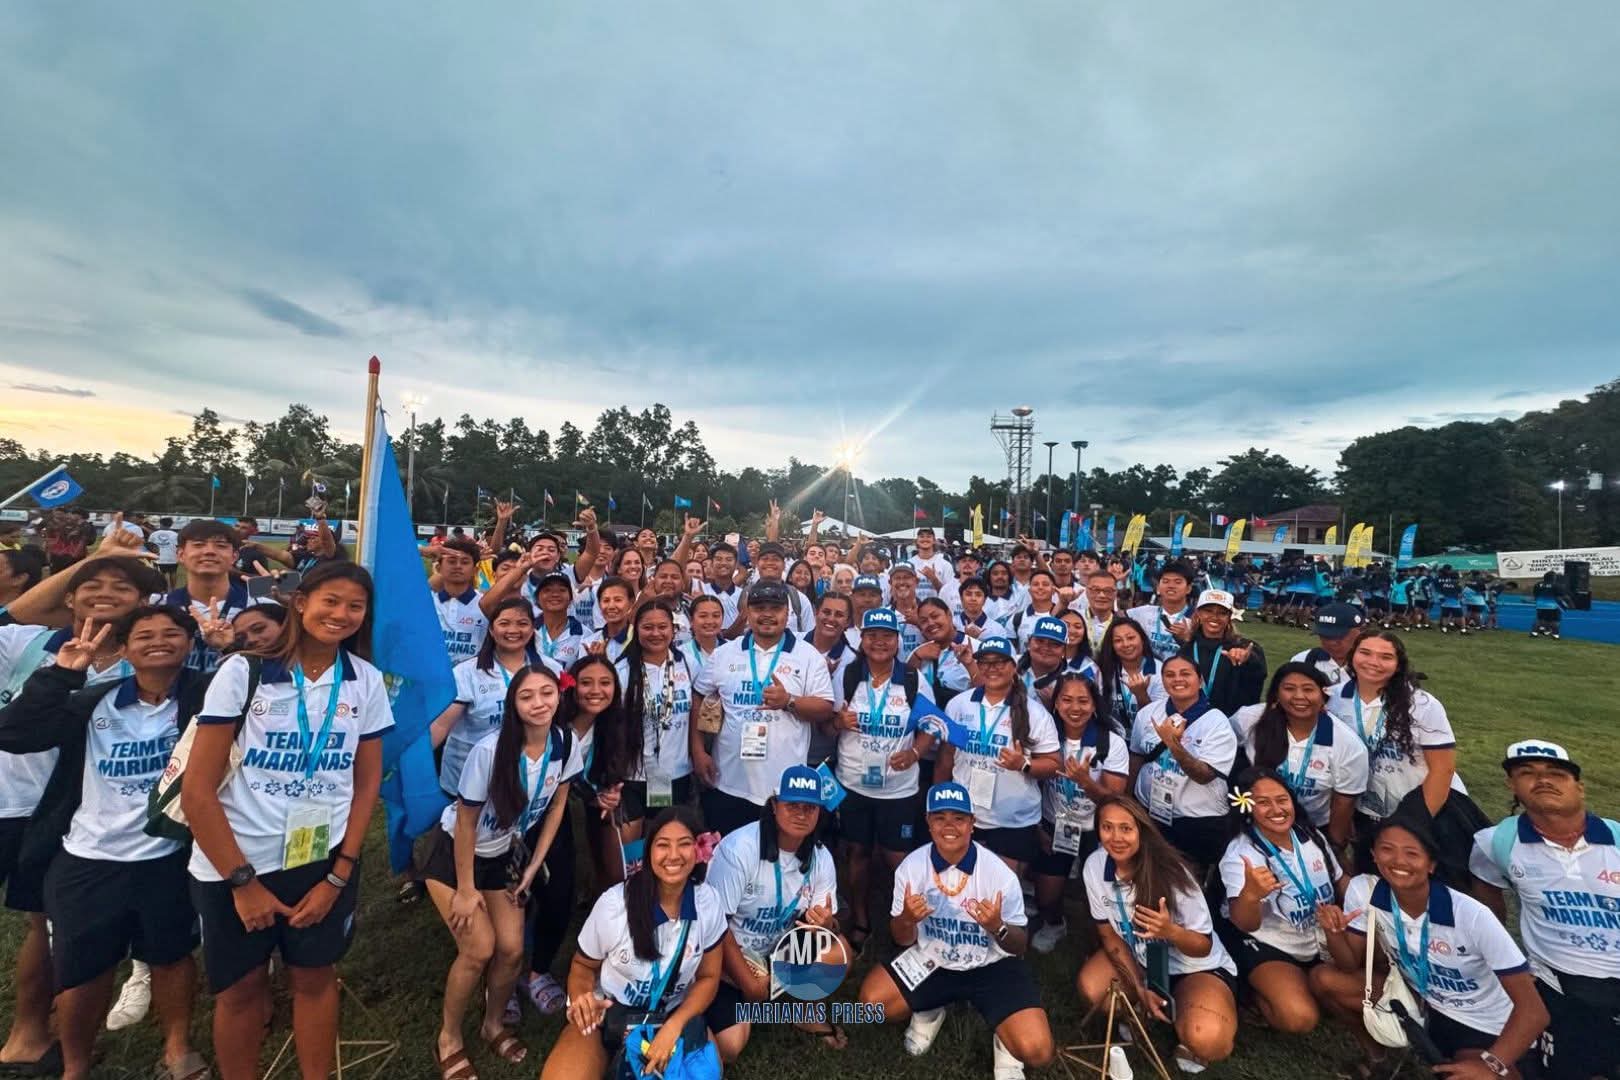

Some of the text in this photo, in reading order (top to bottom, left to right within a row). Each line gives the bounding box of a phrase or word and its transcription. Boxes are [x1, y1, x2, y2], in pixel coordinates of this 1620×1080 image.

[869, 612, 892, 622] NMI
[1040, 622, 1062, 633] NMI
[982, 640, 1004, 649] NMI
[110, 738, 158, 758] TEAM
[788, 778, 816, 790] NMI
[935, 790, 964, 801] NMI
[1542, 890, 1595, 908] TEAM
[1540, 905, 1620, 929] MARIAN
[928, 916, 958, 932] TEAM
